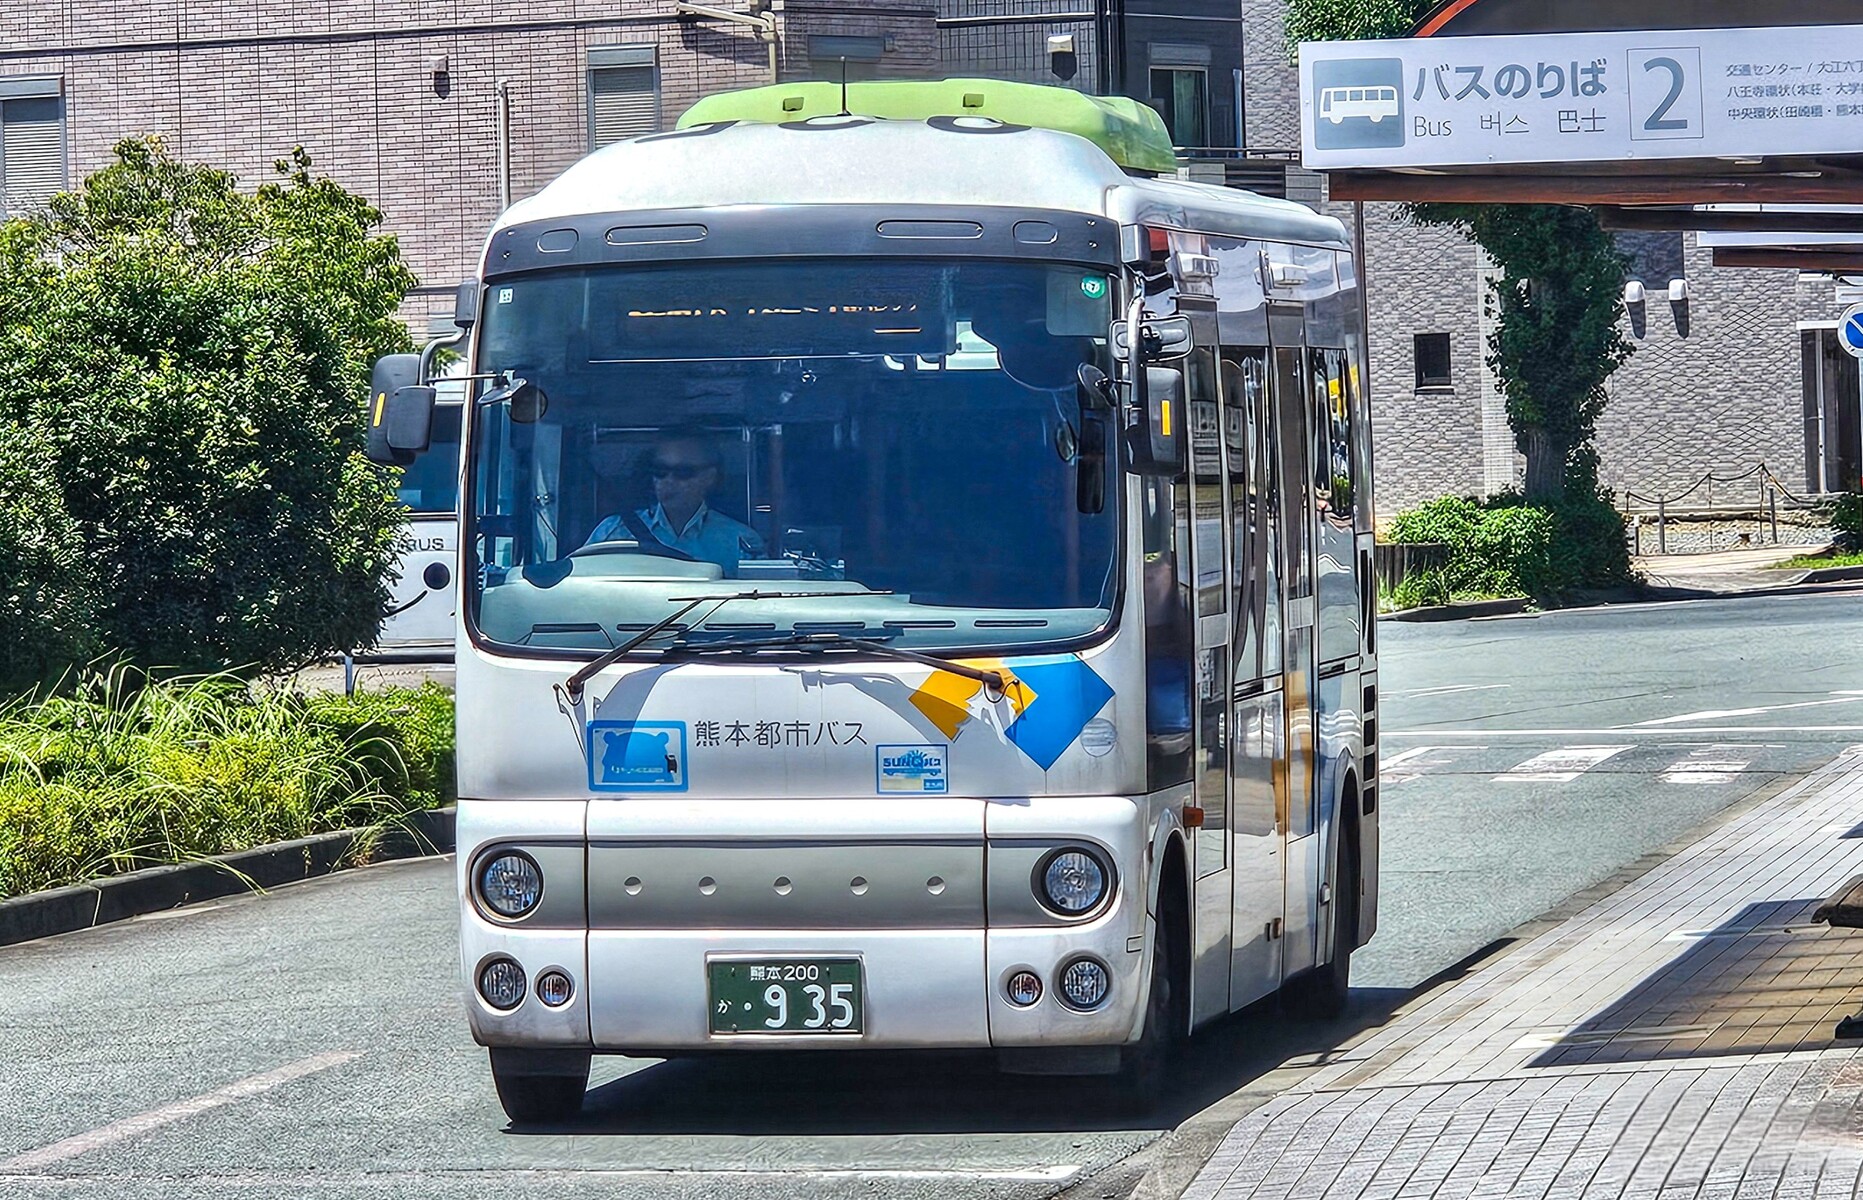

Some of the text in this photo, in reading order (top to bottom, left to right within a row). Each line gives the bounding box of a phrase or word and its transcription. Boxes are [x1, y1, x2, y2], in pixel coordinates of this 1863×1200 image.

[1412, 58, 1608, 101] バスのりば
[1643, 56, 1688, 131] 2
[1413, 115, 1453, 137] Bus
[1479, 111, 1530, 136] 버스
[1558, 108, 1607, 133] 巴士
[694, 720, 868, 749] 熊本都市バス
